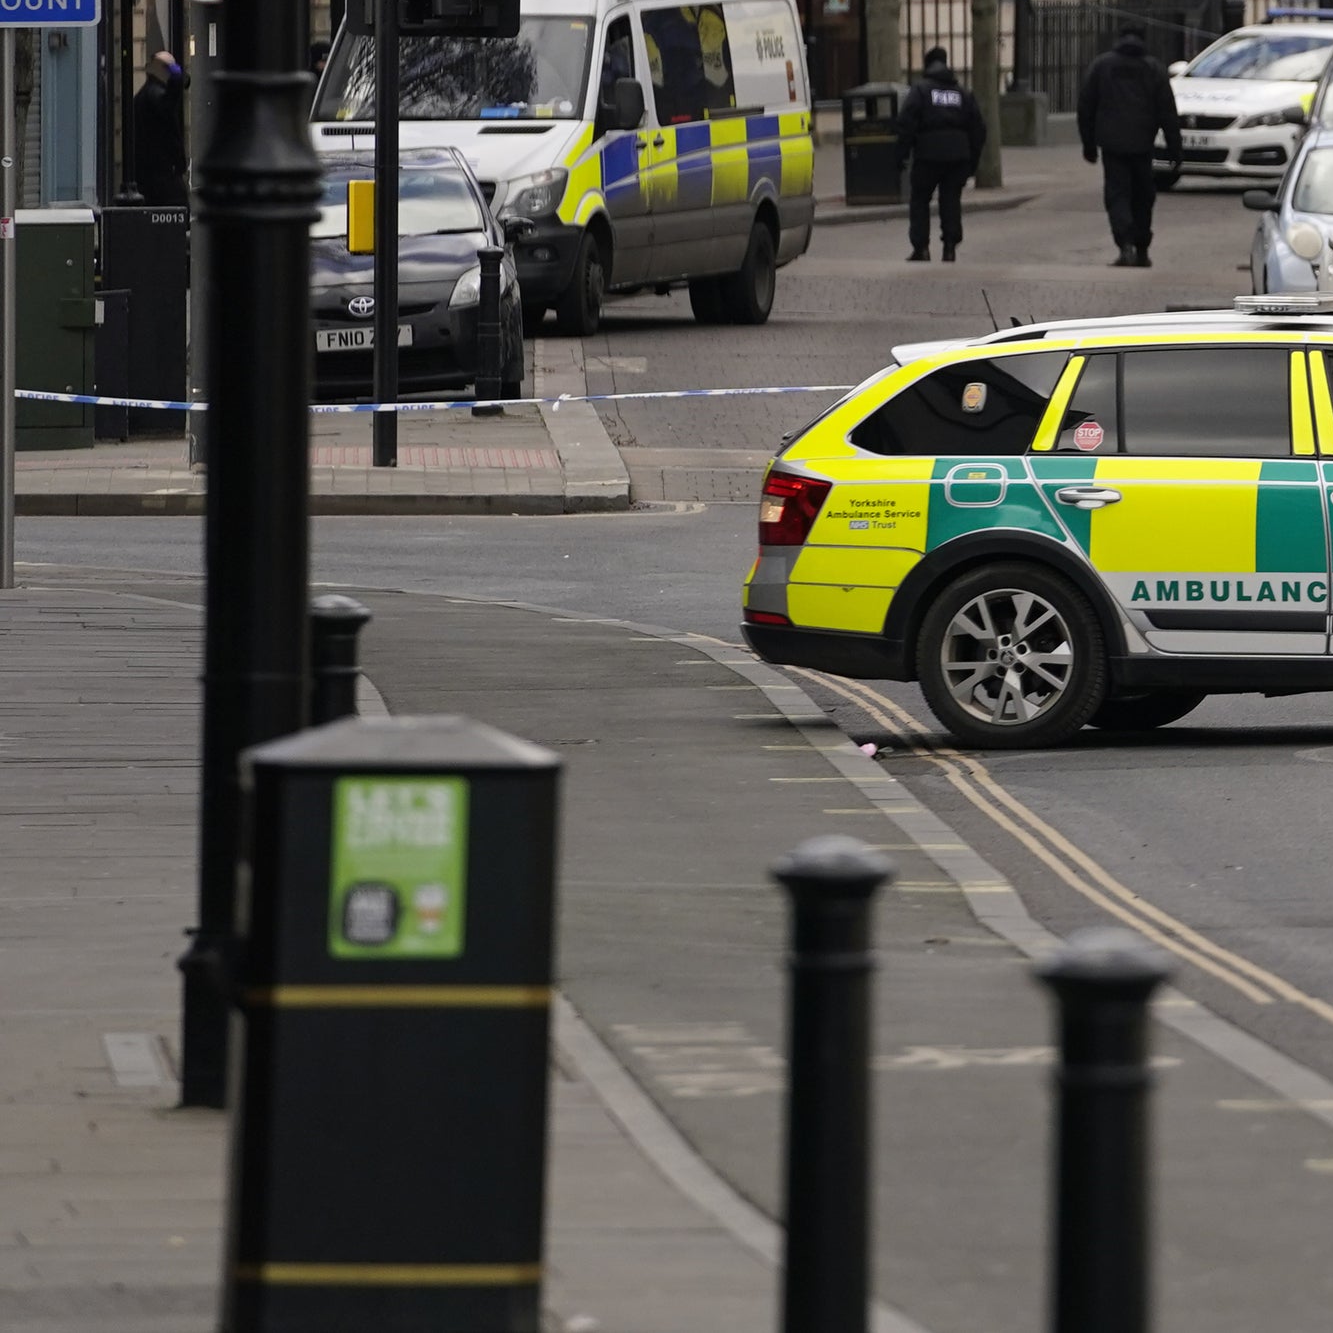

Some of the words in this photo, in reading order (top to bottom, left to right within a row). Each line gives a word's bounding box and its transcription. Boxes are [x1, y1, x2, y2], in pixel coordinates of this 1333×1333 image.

[763, 37, 785, 59] POLICE
[1077, 427, 1101, 437] STOP
[849, 499, 897, 508] Yorkshire
[826, 510, 881, 519] Ambulance
[884, 510, 921, 518] Service
[872, 521, 897, 529] Trust
